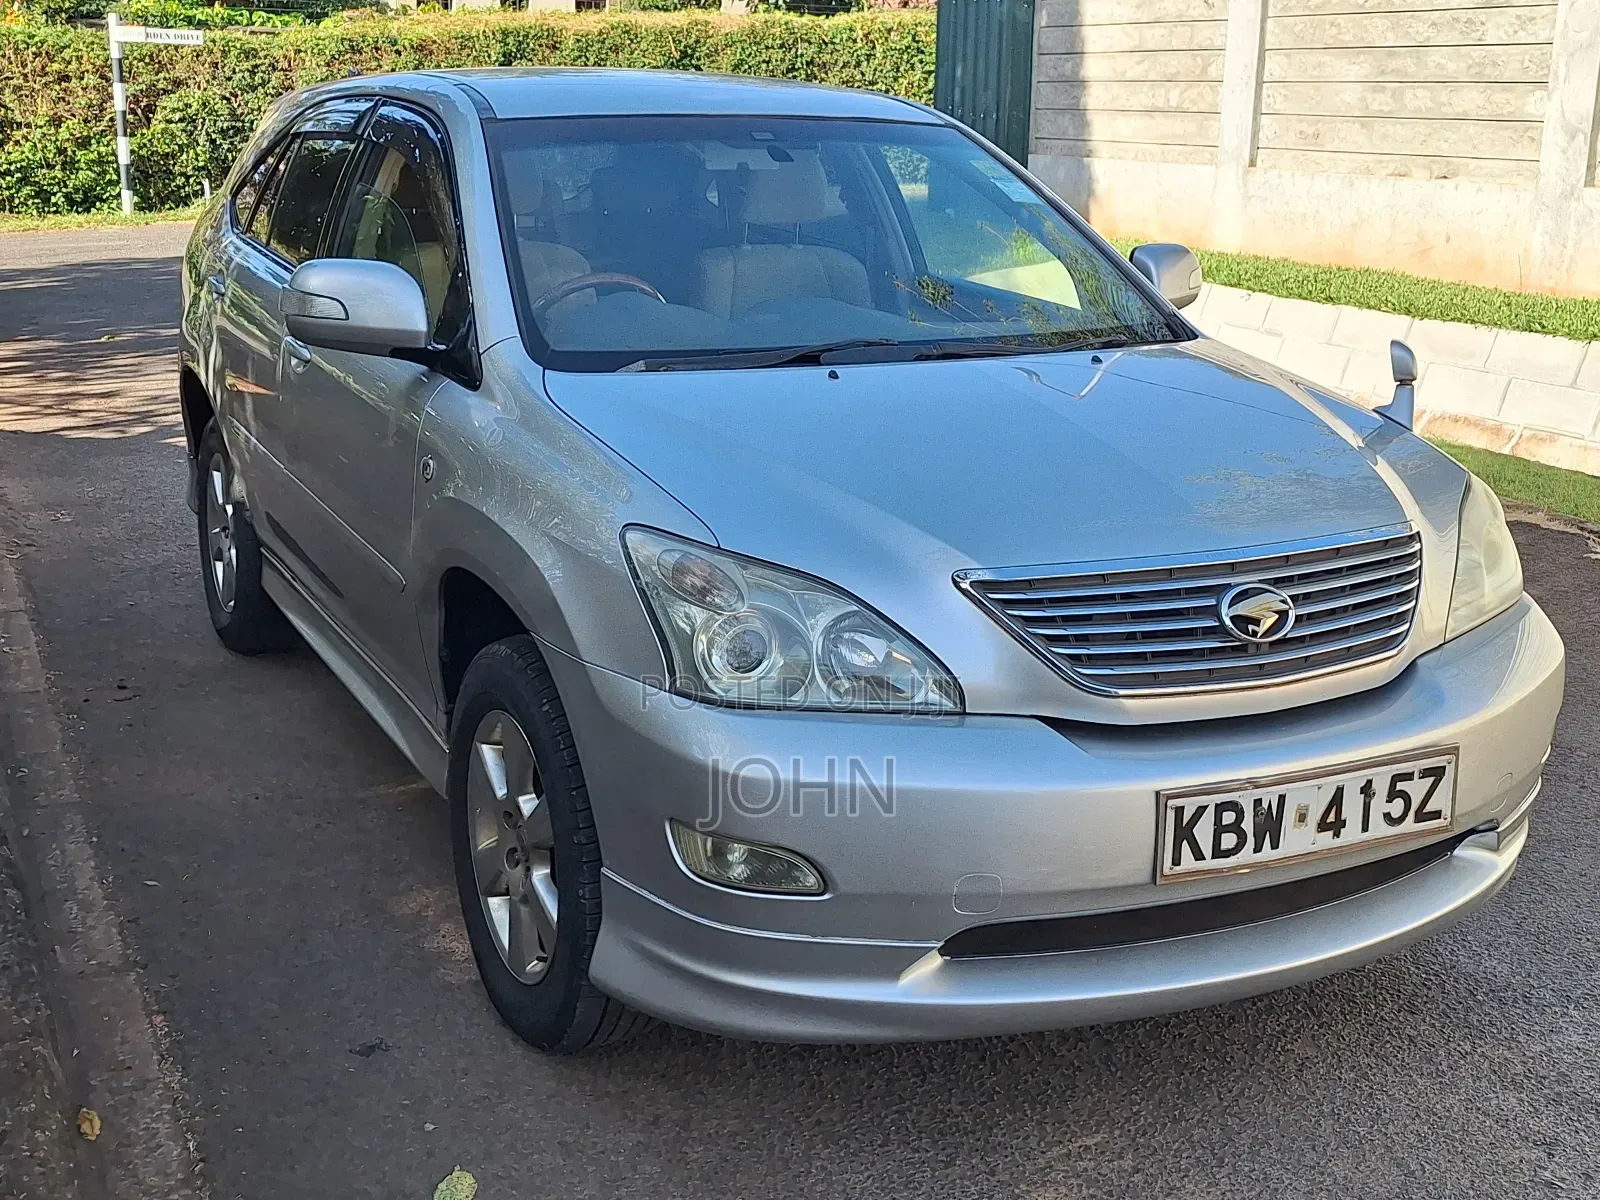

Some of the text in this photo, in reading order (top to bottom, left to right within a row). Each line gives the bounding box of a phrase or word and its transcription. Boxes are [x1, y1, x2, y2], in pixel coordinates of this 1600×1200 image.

[173, 33, 200, 41] DRIVE
[1171, 765, 1447, 866] KBW 415Z
